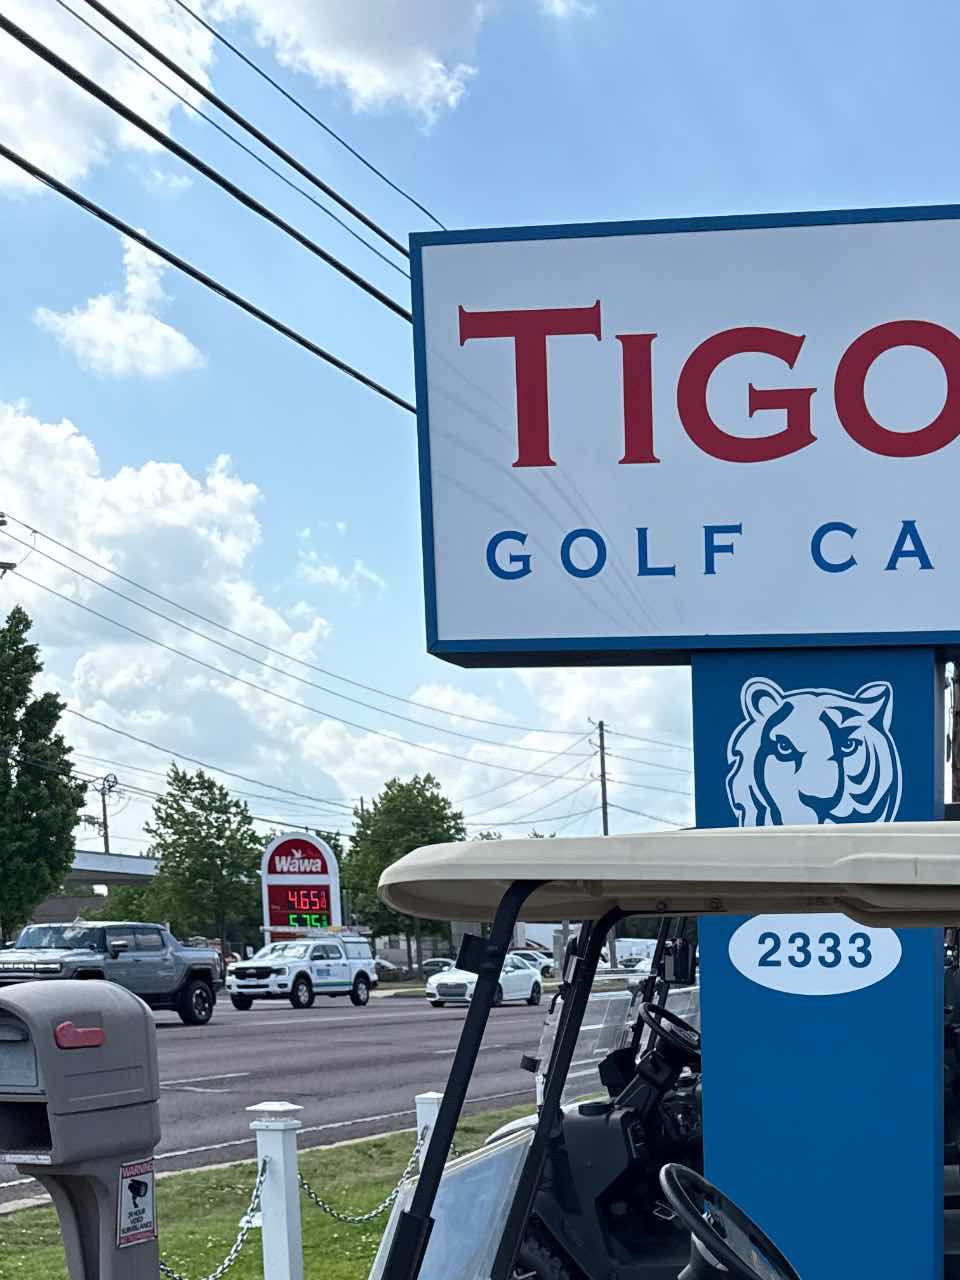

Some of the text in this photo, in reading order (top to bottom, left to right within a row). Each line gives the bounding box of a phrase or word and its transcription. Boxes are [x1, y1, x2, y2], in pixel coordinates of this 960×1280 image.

[486, 522, 743, 581] GOLF
[274, 856, 322, 872] Wawa
[758, 931, 873, 969] 2333
